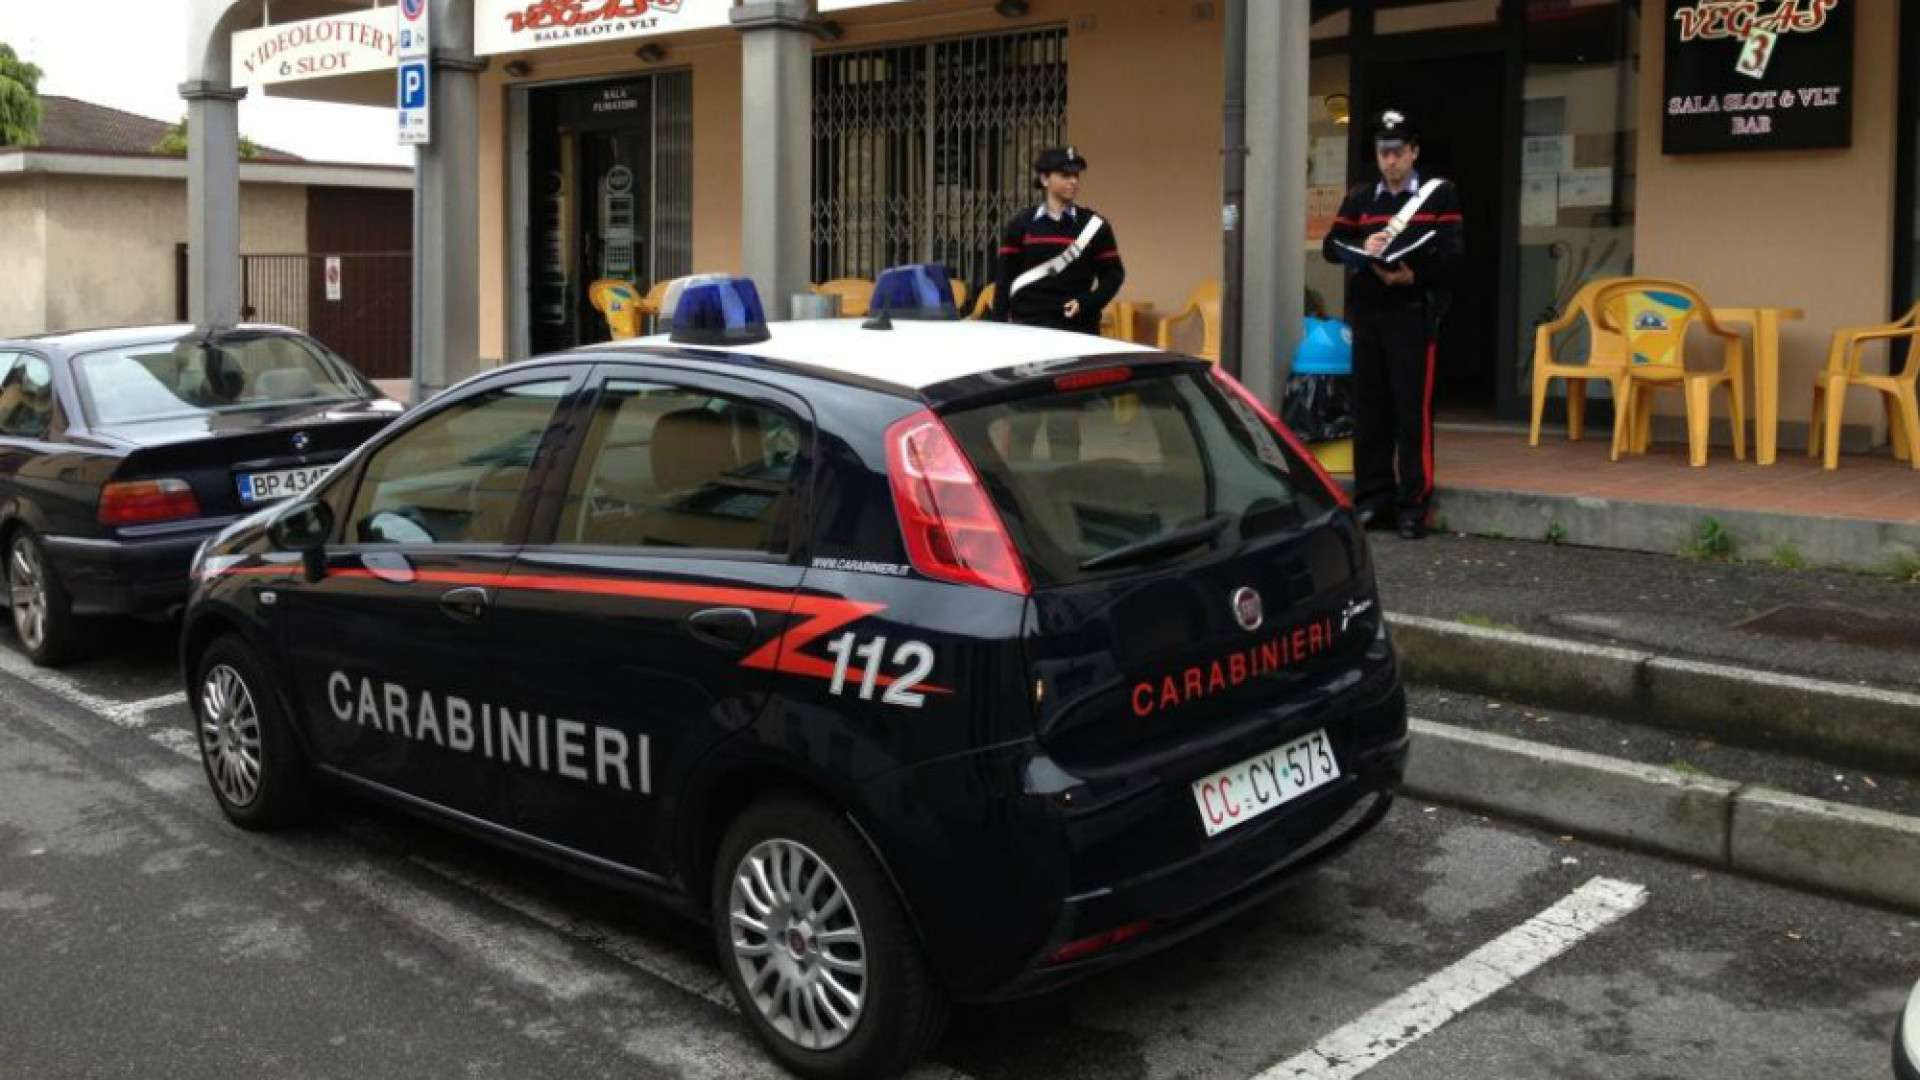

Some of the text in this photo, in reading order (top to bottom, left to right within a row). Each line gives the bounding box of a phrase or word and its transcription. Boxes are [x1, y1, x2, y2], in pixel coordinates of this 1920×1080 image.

[535, 18, 658, 41] SALA SLOT & VLT
[1674, 0, 1837, 42] VEGAS
[243, 20, 398, 73] VIDEOLOTTERY
[279, 52, 350, 76] & SLOT
[1742, 34, 1769, 70] 3
[406, 70, 421, 104] P
[1668, 86, 1841, 114] SALA SLOT & VLT
[1731, 116, 1772, 135] BAR
[253, 467, 331, 497] BP 434
[827, 632, 935, 709] 112
[1131, 617, 1332, 717] CARABINIERI
[327, 670, 651, 795] CARABINIERI
[1202, 732, 1332, 825] CC CY 573
